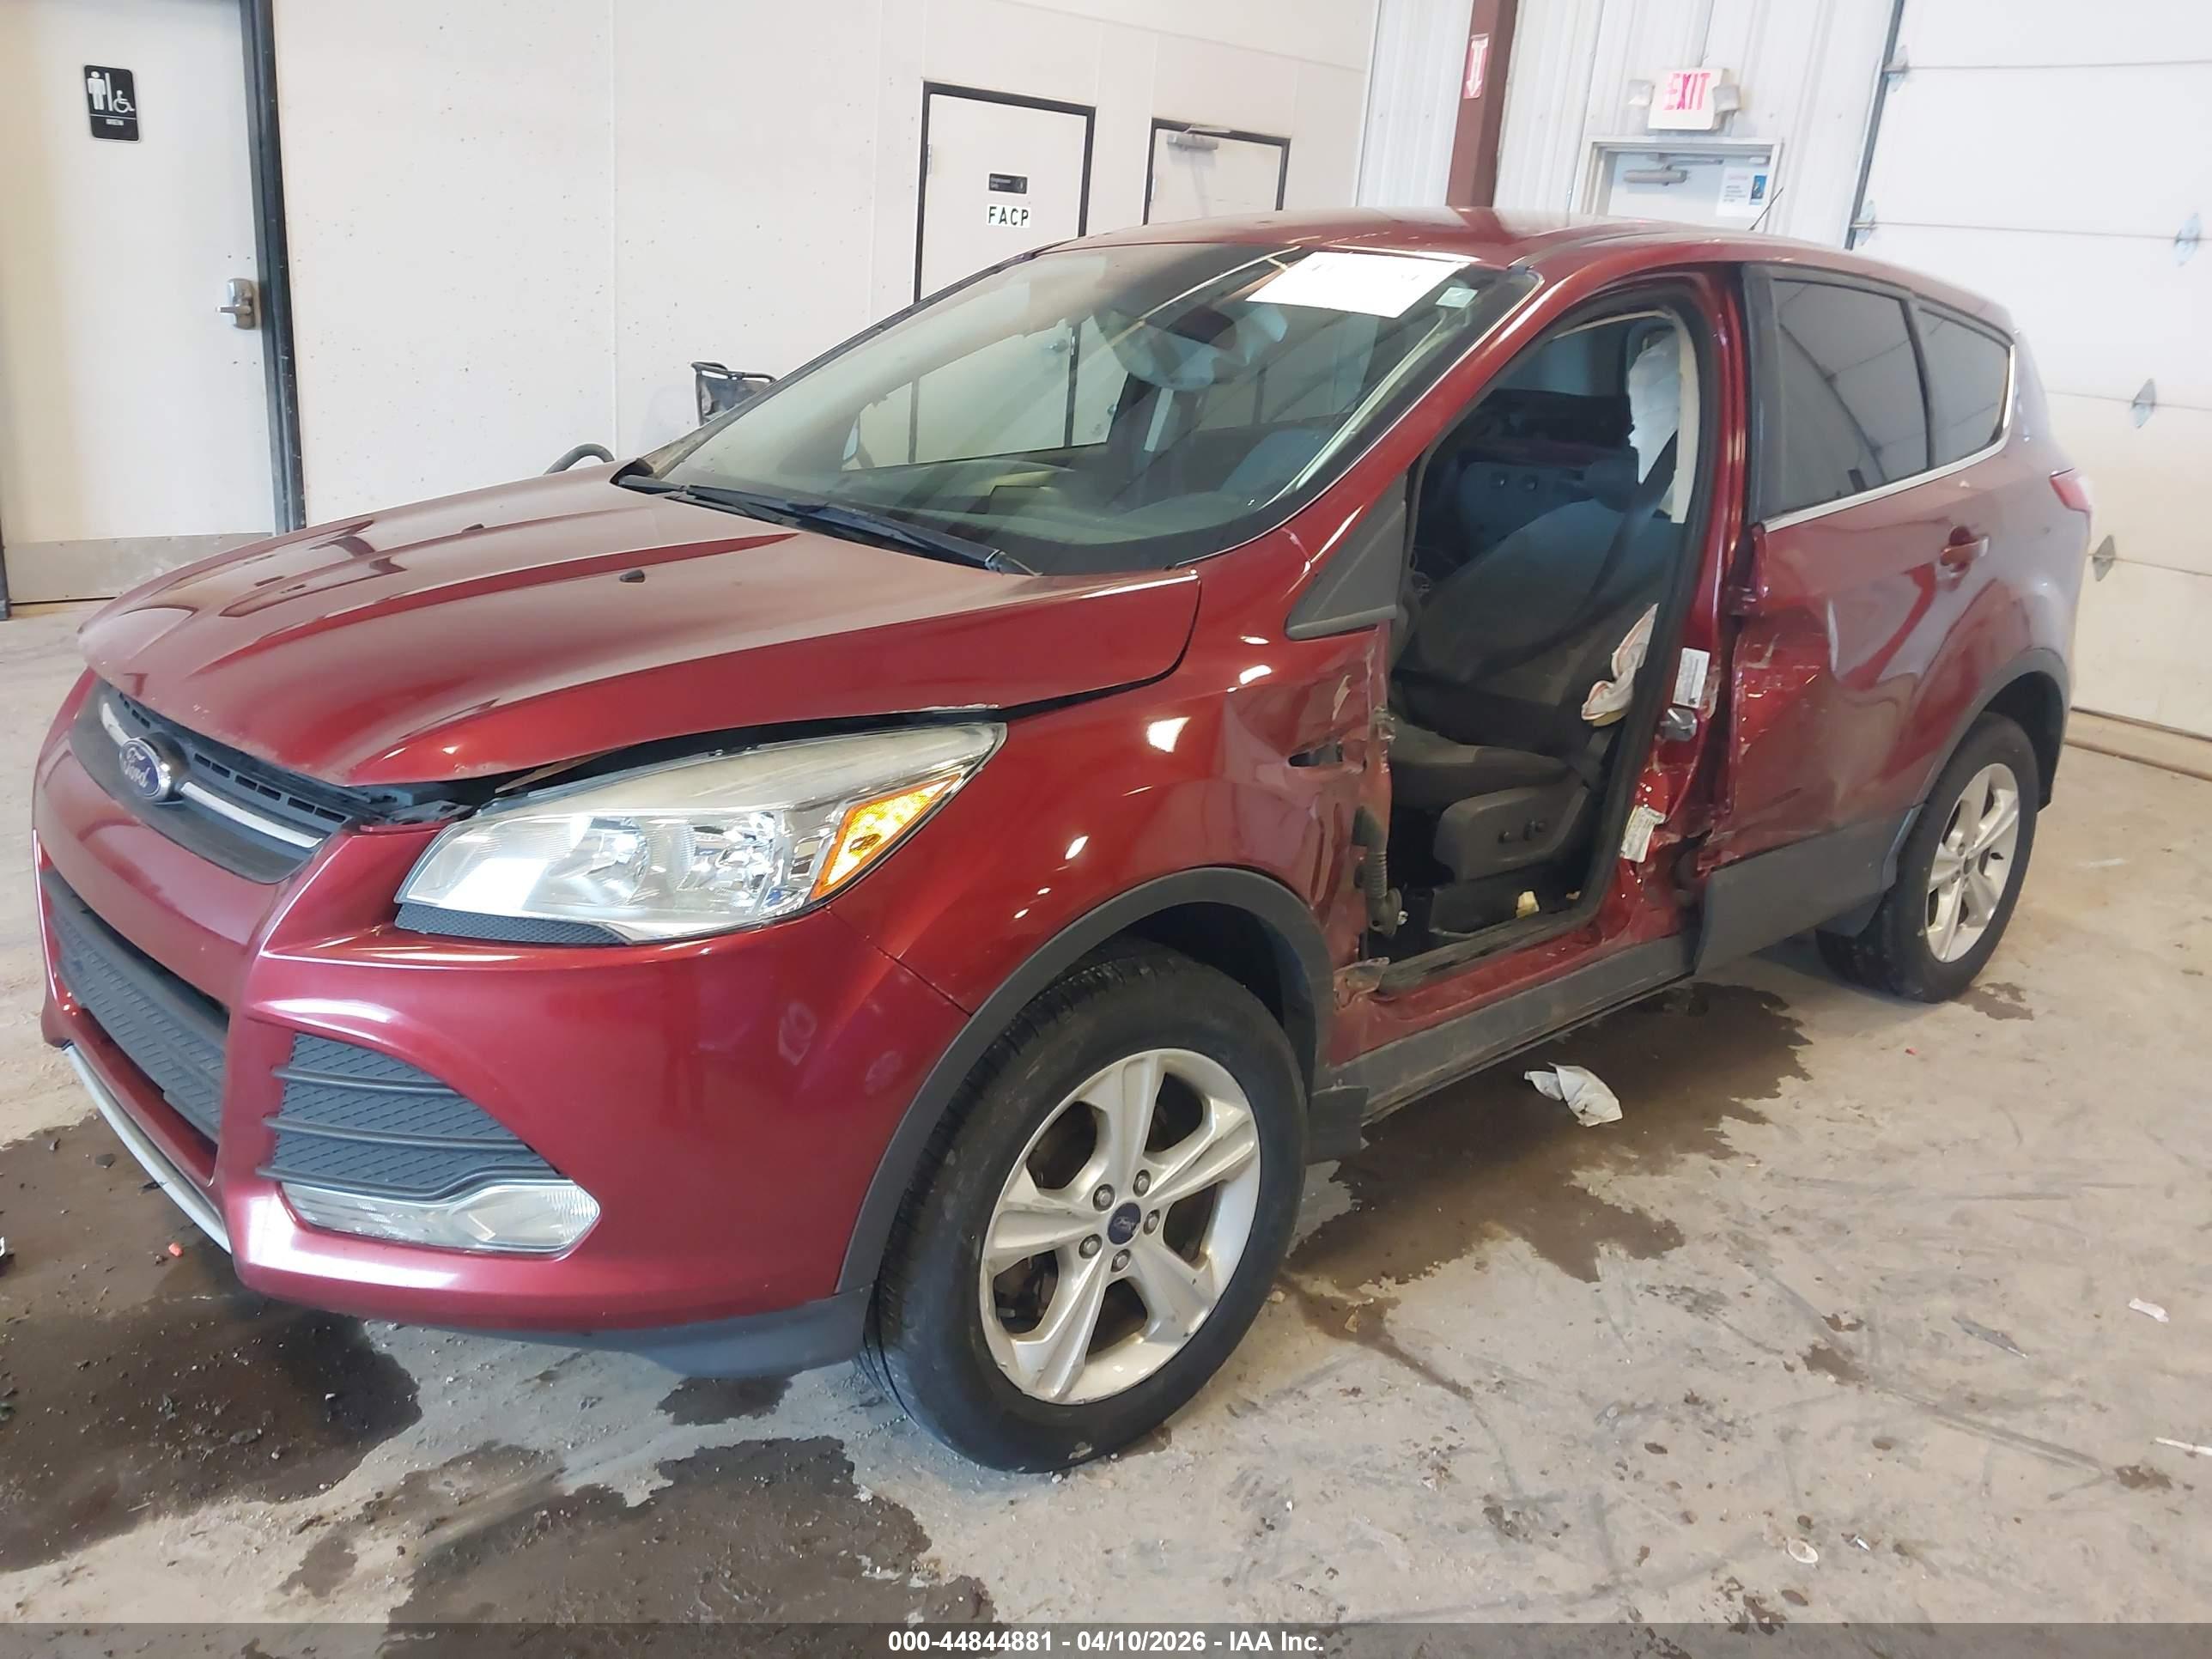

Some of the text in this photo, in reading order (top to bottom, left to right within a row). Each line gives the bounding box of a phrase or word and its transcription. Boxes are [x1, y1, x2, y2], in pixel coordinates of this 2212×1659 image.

[1663, 72, 1711, 111] EXIT
[988, 205, 1029, 227] FACP
[123, 747, 151, 788] Ford
